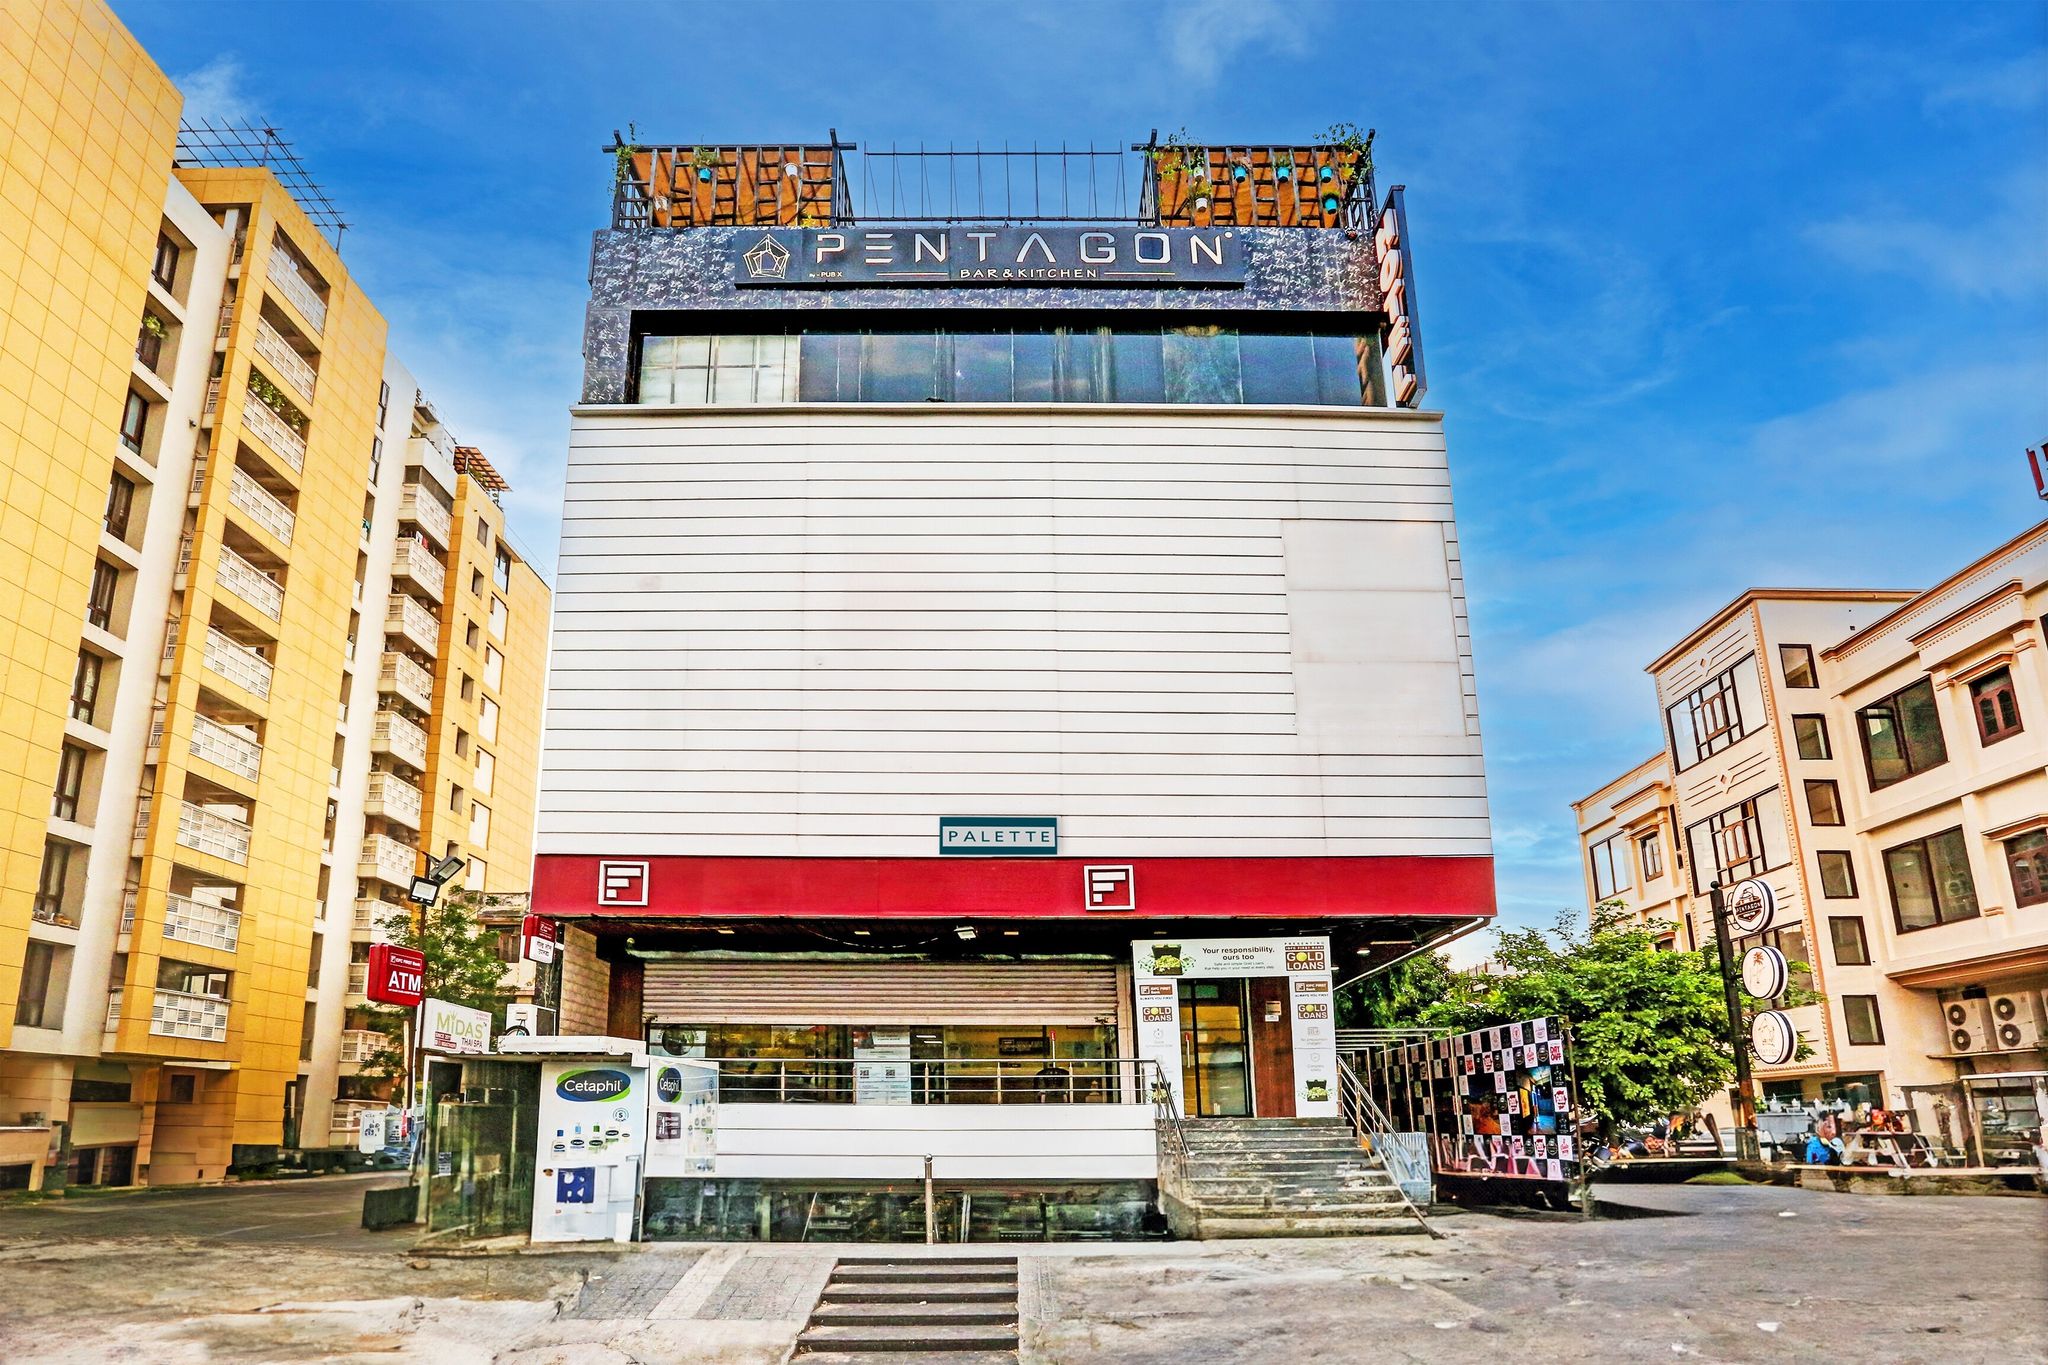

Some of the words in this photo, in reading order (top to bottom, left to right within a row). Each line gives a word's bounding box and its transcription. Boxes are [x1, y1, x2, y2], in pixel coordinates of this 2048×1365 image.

[816, 232, 1223, 265] PENTAGON
[1374, 207, 1417, 402] HOTEL
[948, 830, 1050, 842] PALETTE
[1287, 962, 1324, 970] LOANS
[388, 970, 421, 992] ATM
[462, 1038, 472, 1046] THAI
[473, 1039, 483, 1048] SPA
[564, 1080, 622, 1094] Cetaphil
